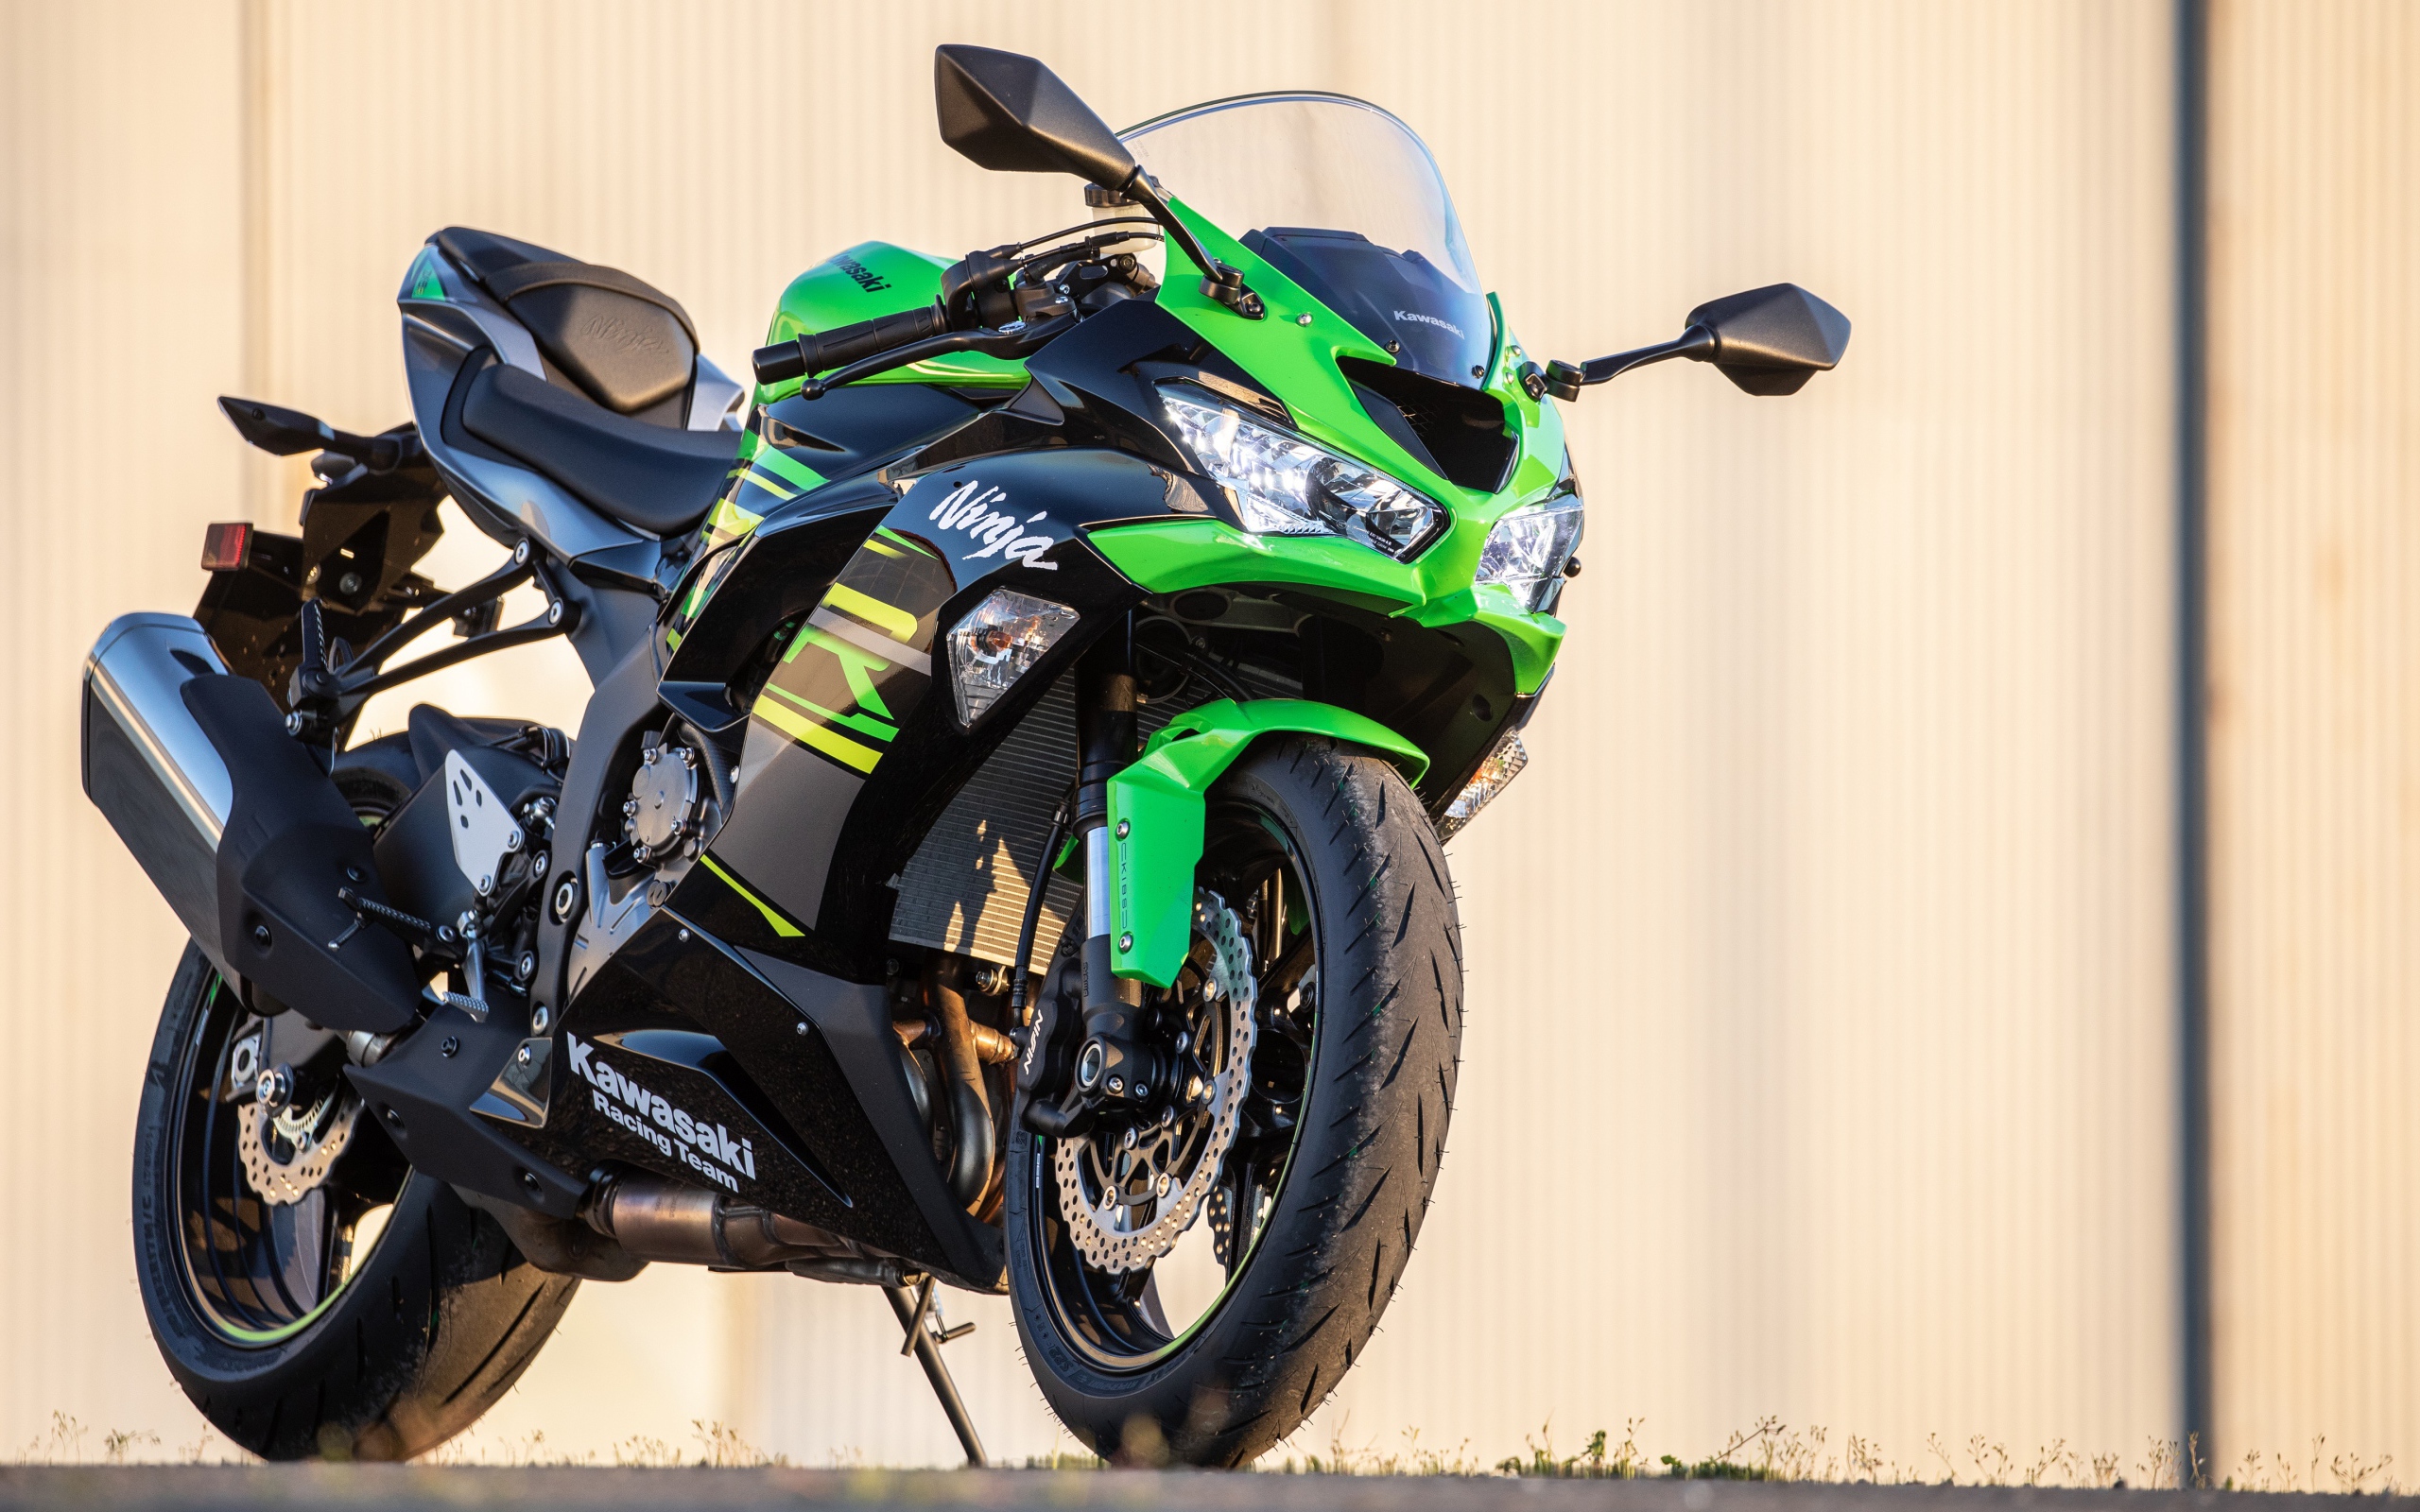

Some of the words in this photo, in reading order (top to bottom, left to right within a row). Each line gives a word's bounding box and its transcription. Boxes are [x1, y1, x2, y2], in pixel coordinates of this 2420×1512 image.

[830, 250, 891, 293] wasaki
[580, 313, 669, 354] Ninja
[1393, 310, 1464, 340] Kawasaki
[929, 480, 1058, 571] Ninja
[567, 1031, 756, 1180] Kawasaki
[592, 1089, 672, 1158] Racing
[673, 1138, 739, 1194] Team
